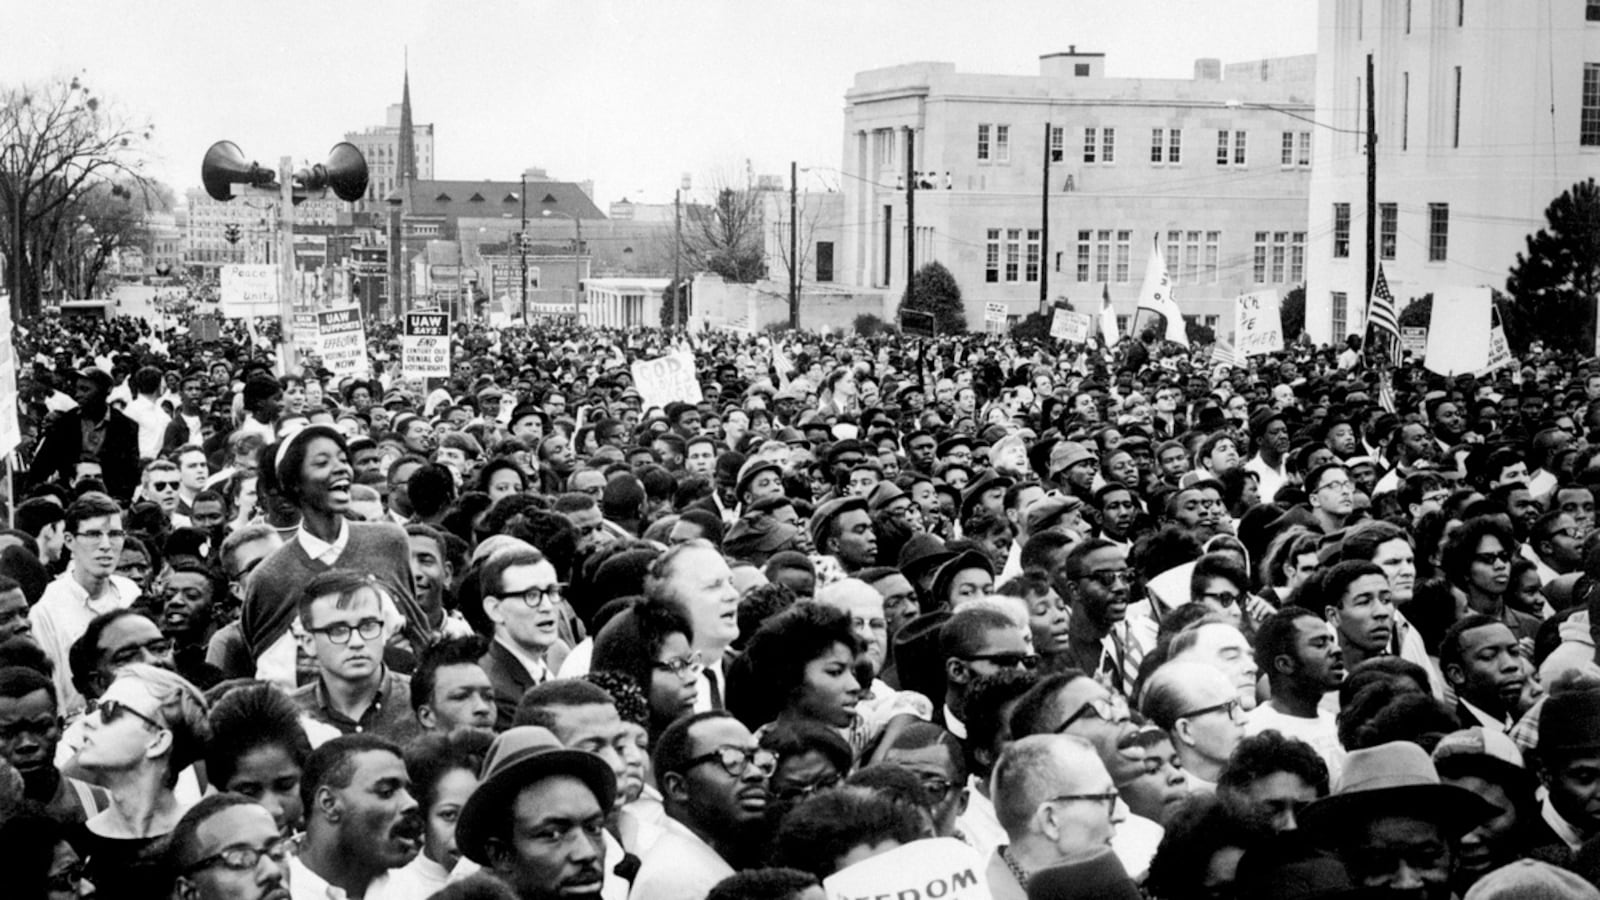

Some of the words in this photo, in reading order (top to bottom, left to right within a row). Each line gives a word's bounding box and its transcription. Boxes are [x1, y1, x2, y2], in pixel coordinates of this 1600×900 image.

[232, 266, 267, 278] Peace
[326, 311, 350, 324] UAW
[411, 315, 442, 327] UAW
[320, 320, 360, 333] SUPPORTS
[323, 334, 359, 349] EFFECTIVE
[416, 337, 438, 347] END
[347, 349, 361, 358] LAW
[433, 347, 448, 355] OLD
[335, 359, 356, 370] NOW
[406, 355, 432, 363] DENIAL
[433, 355, 444, 363] OF
